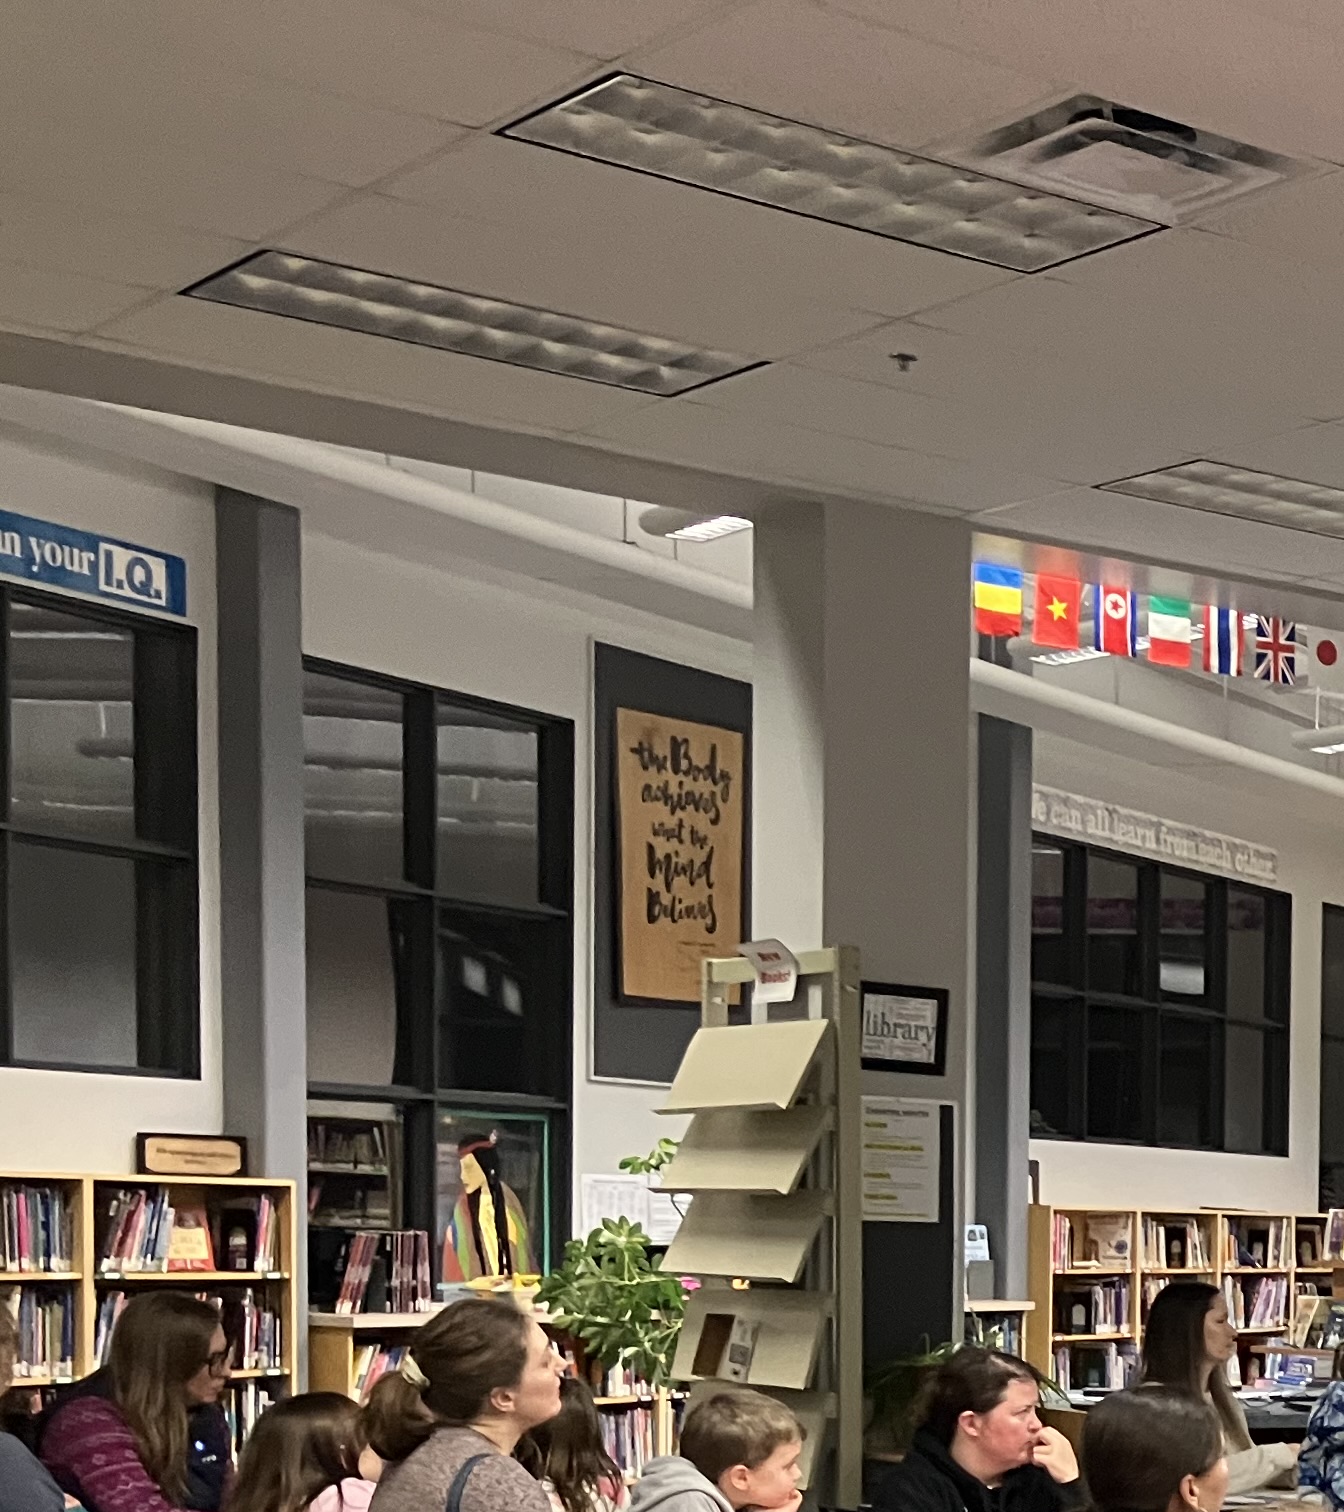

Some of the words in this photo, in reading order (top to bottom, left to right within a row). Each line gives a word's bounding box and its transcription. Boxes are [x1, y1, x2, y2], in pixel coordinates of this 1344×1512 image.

[29, 536, 95, 576] your
[104, 549, 162, 600] I.Q.
[630, 741, 668, 773] the
[670, 735, 732, 803] Body
[641, 780, 720, 826] achieves
[652, 818, 684, 844] what
[1051, 804, 1082, 832] can
[1086, 808, 1110, 836] all
[1114, 813, 1157, 849] learn
[865, 1010, 936, 1047] library
